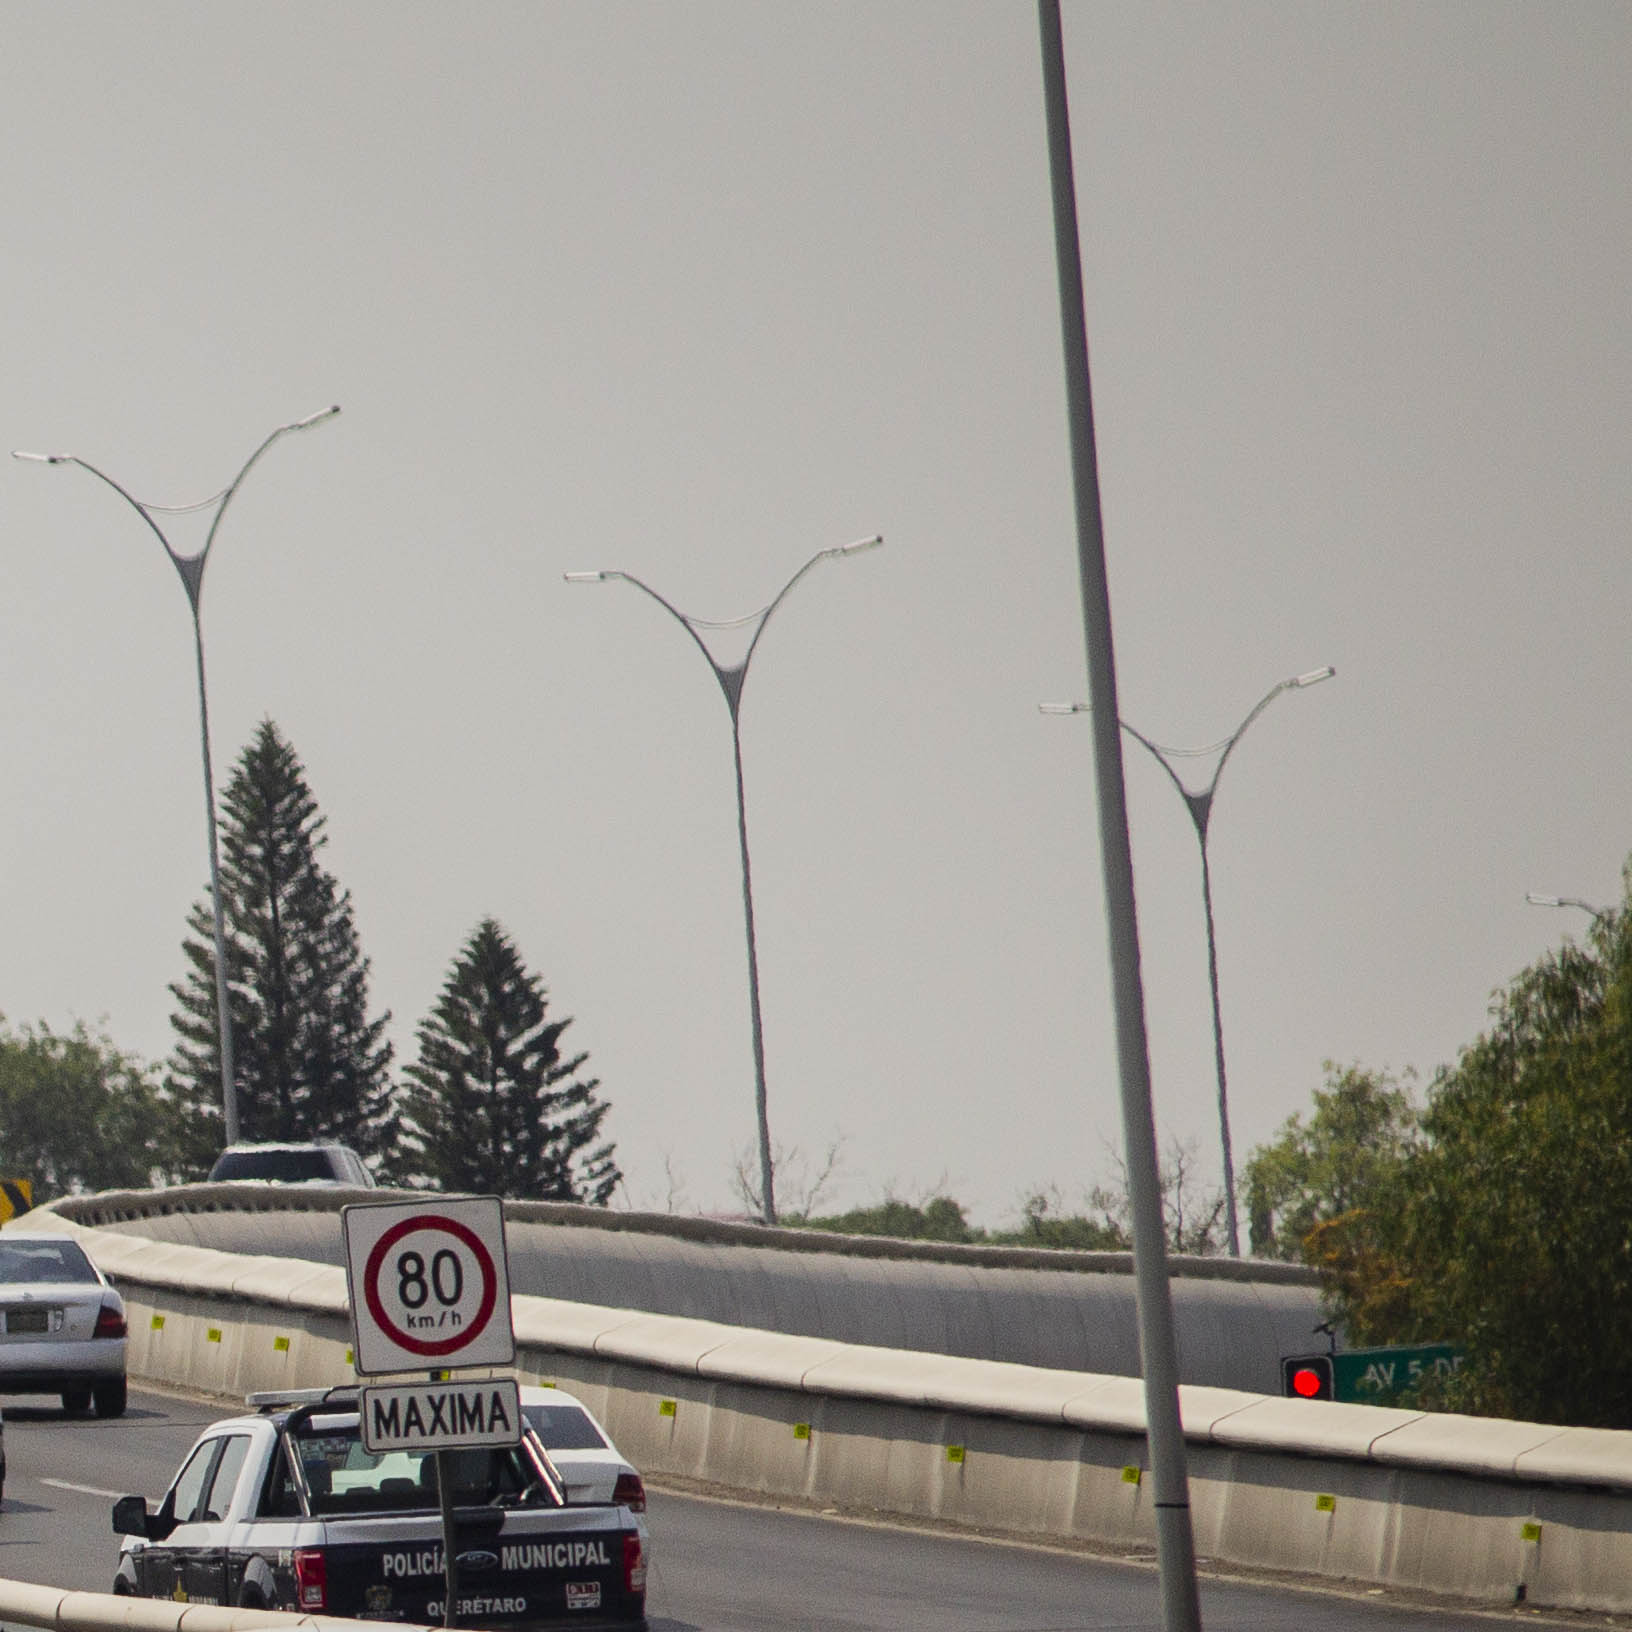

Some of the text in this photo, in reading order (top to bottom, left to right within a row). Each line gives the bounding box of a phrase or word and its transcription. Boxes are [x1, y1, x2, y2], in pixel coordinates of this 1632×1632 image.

[397, 1249, 464, 1309] 80
[407, 1310, 462, 1329] km/h
[1364, 1360, 1396, 1391] AV
[373, 1390, 511, 1439] MAXIMA
[383, 1541, 610, 1577] POLICÍA MUNICIPAL
